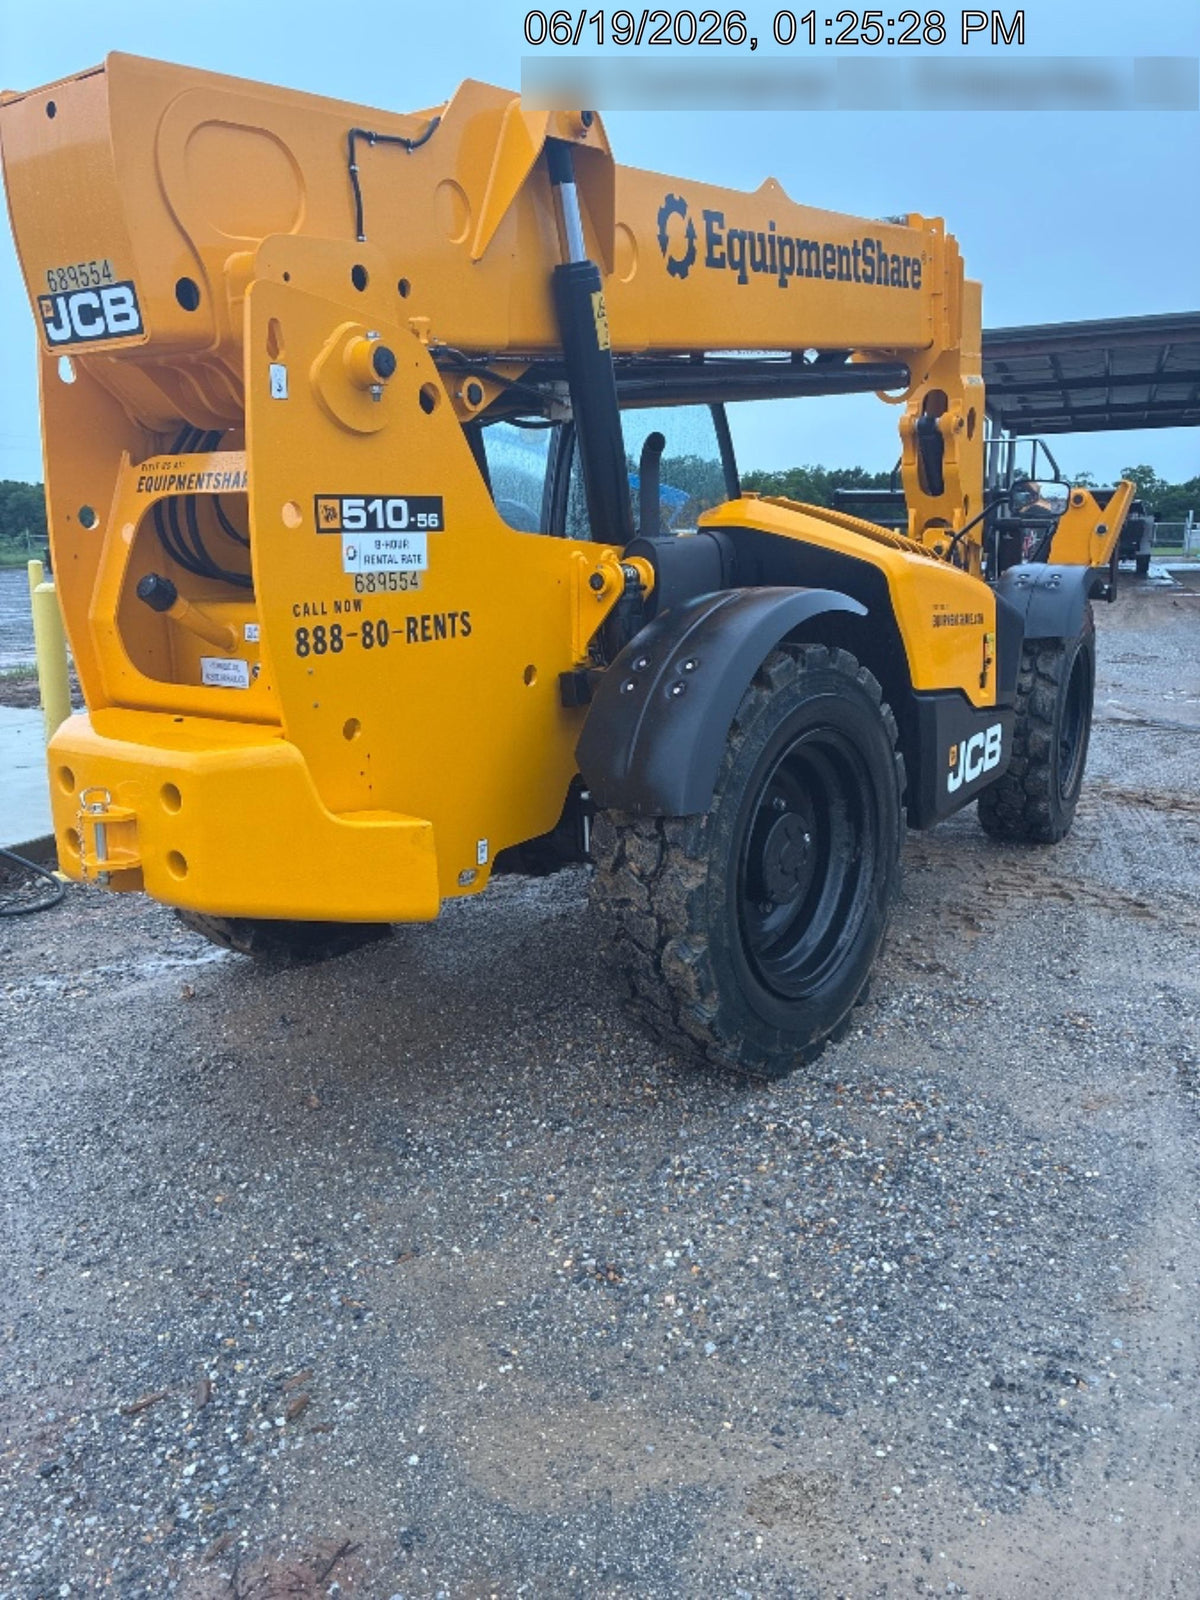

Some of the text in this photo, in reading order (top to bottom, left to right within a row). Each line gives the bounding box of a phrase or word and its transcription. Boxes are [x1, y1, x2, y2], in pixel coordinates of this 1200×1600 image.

[702, 208, 922, 290] EquipmentShare
[46, 259, 113, 292] 689554
[45, 286, 140, 341] JCB
[363, 553, 422, 565] RENTAL RATE
[354, 571, 419, 593] 689554
[292, 599, 363, 618] CALL NOW
[295, 611, 472, 658] 888-80-RENTS
[947, 722, 1002, 794] JCB
